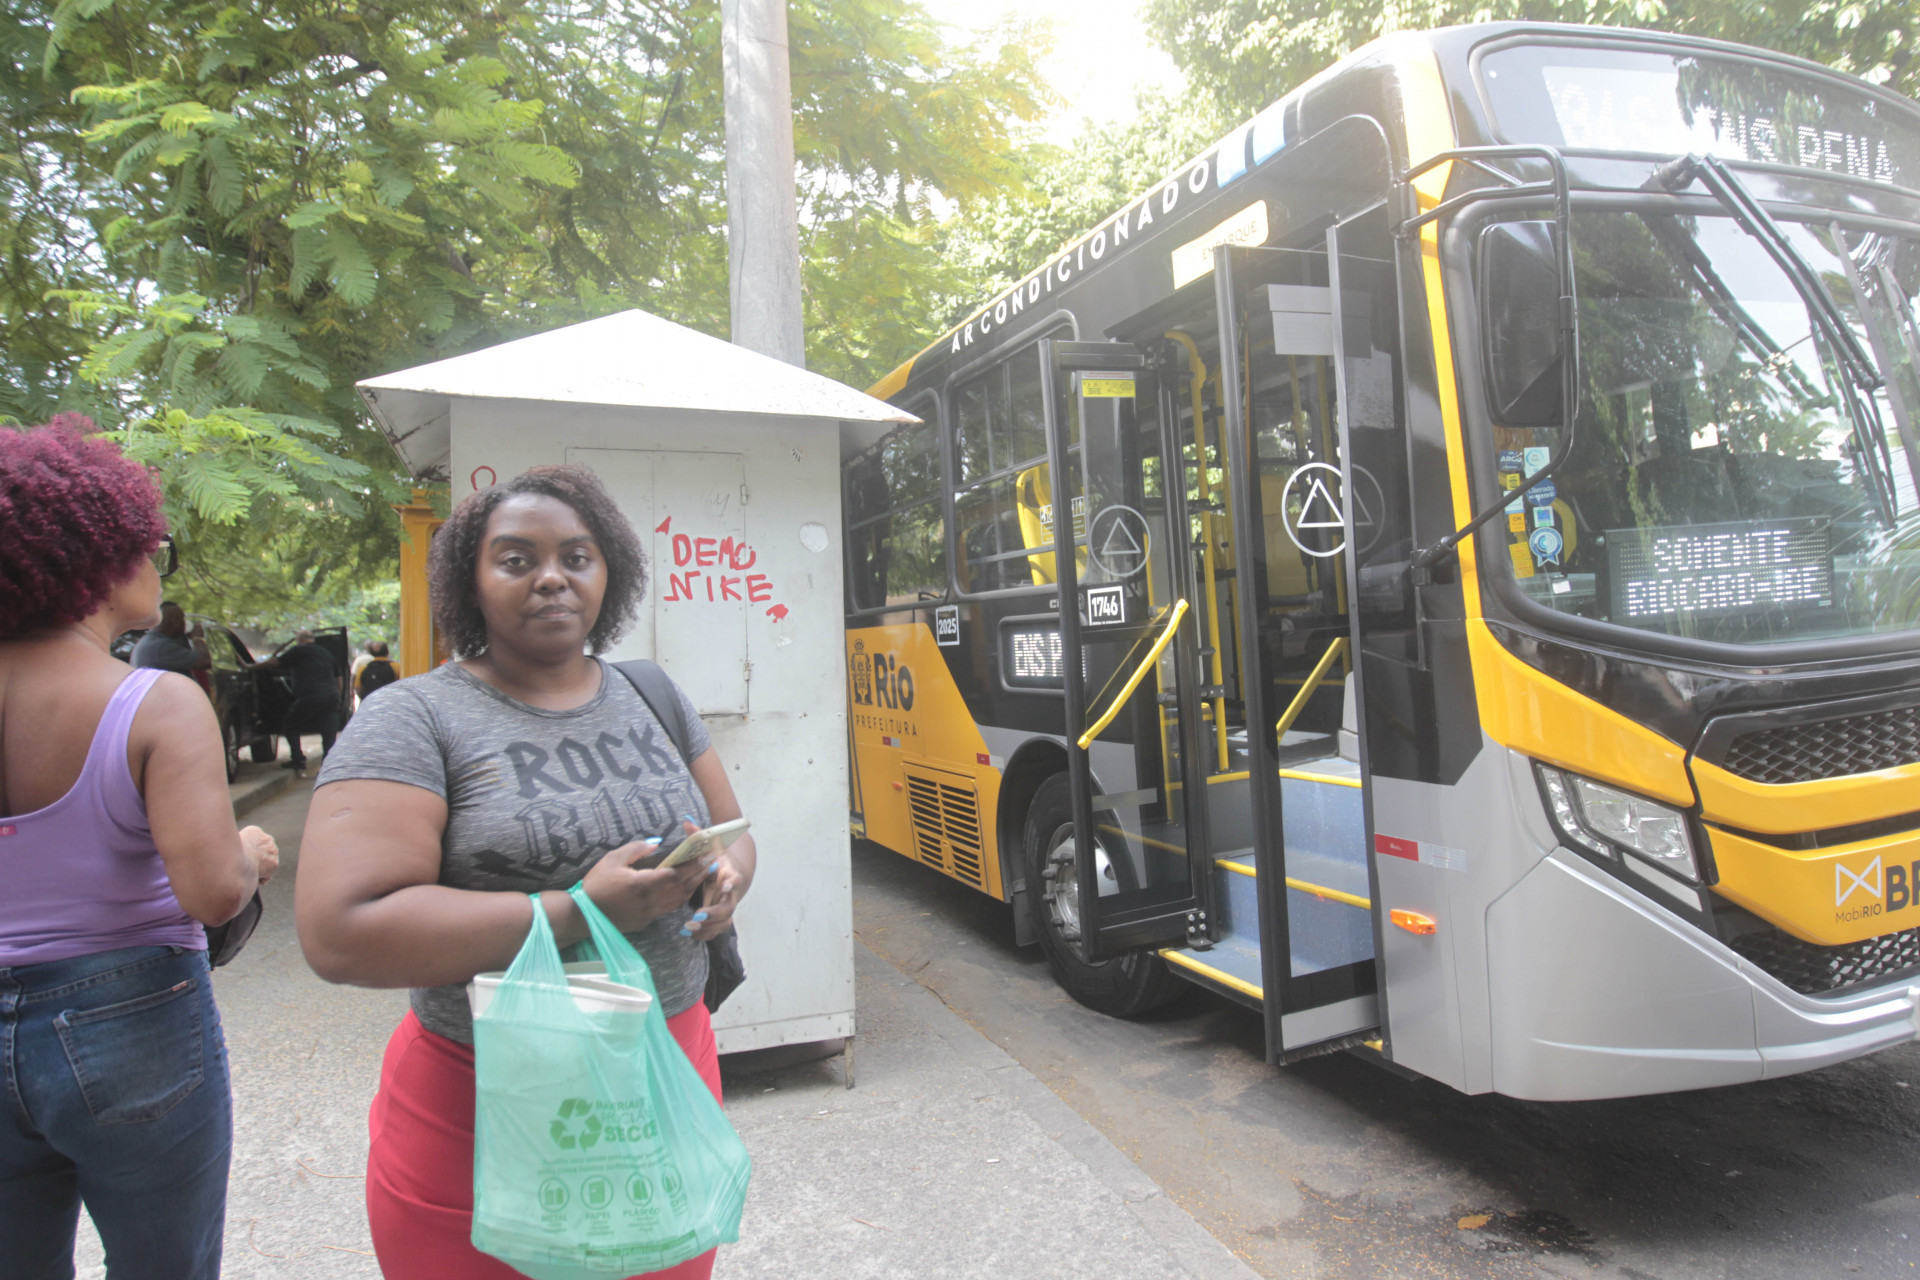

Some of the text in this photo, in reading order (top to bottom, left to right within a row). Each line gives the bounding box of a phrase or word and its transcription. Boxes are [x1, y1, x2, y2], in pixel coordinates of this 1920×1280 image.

[980, 159, 1210, 335] CONDICIONADO
[1654, 530, 1791, 573] SOMENTE
[663, 571, 773, 602] NIKE
[1091, 595, 1119, 617] 1746
[938, 618, 957, 635] 2025
[873, 652, 914, 712] Rio
[855, 714, 918, 737] PREFEITURA
[503, 722, 680, 799] ROCK
[1835, 903, 1882, 925] MobiRIO
[585, 1211, 612, 1220] PAPEL
